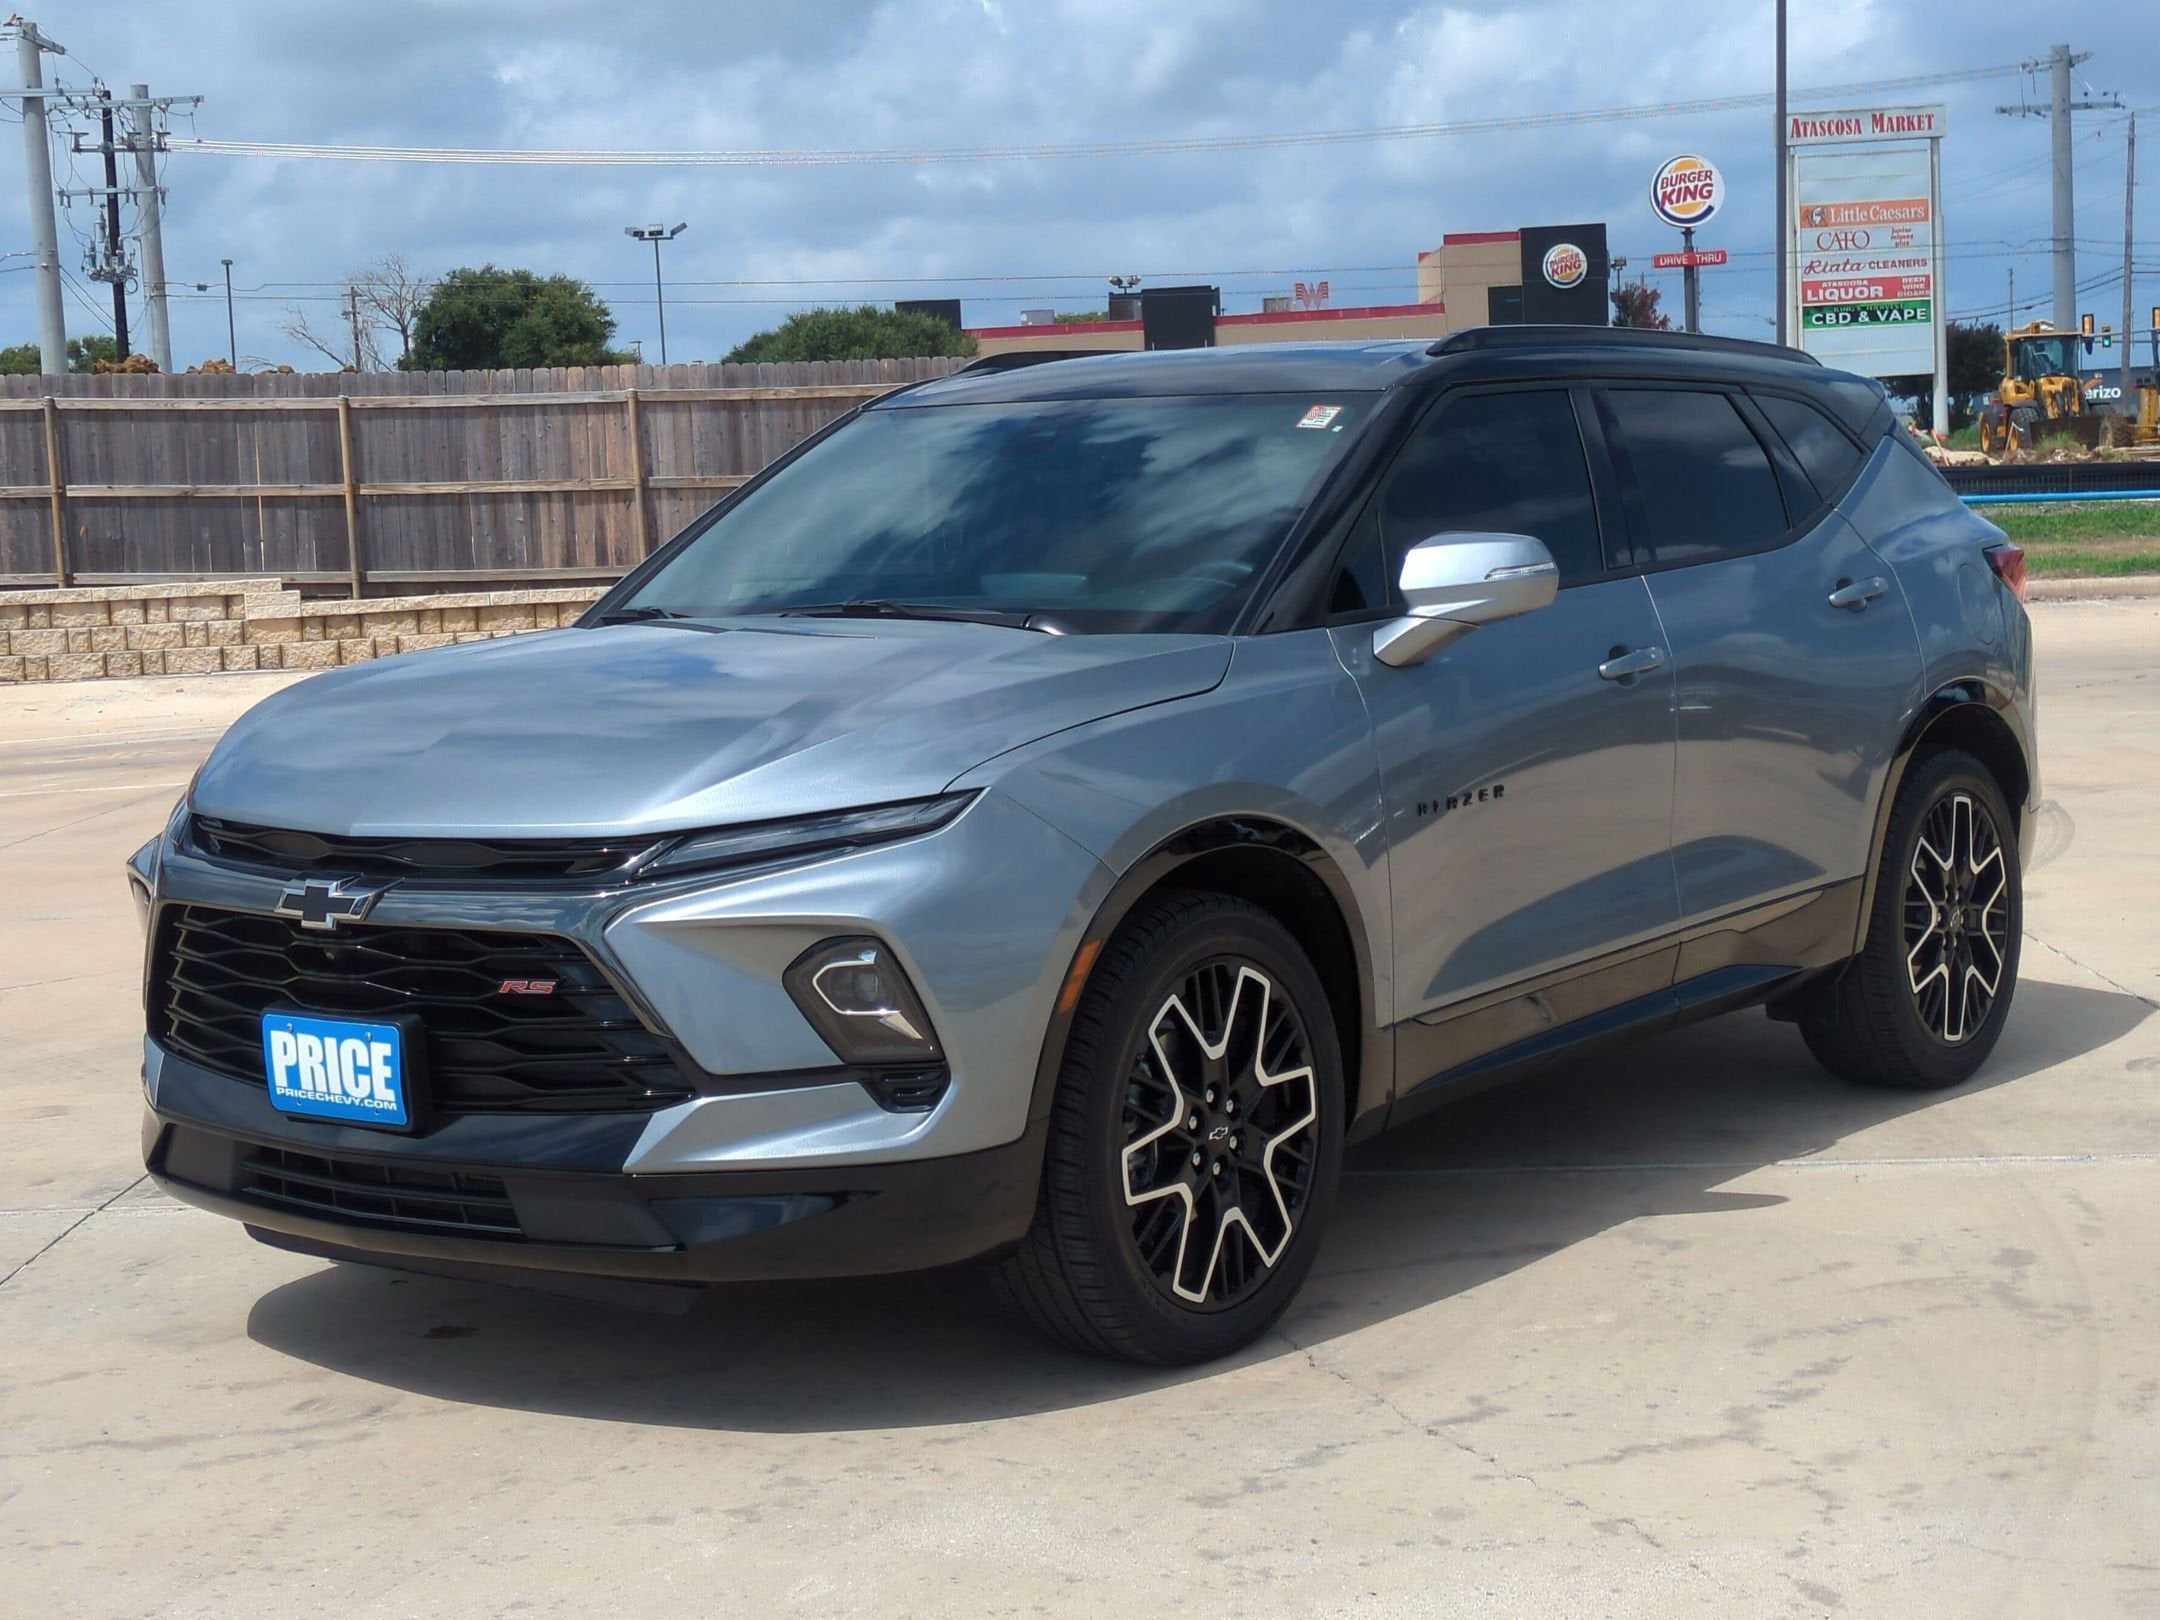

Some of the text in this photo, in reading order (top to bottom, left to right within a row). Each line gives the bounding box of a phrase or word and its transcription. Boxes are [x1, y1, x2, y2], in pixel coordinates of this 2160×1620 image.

[1790, 113, 1935, 139] ATASCOSA MARKET
[1660, 169, 1713, 190] BURGER
[1660, 183, 1714, 208] KING
[1831, 205, 1925, 224] Little Caesars
[1817, 230, 1870, 251] CATO
[1550, 252, 1580, 269] BURGER
[1660, 252, 1722, 266] DRIVE THRU
[1804, 258, 1928, 275] Riata CLEANERS
[1551, 261, 1581, 278] KING
[1807, 286, 1884, 301] LIQUOR
[1811, 308, 1927, 325] CBD & VAPE
[2084, 385, 2121, 399] erizo
[499, 980, 556, 995] RS
[270, 1030, 396, 1102] PRICE
[276, 1087, 398, 1112] PRICECHEVY.COM
